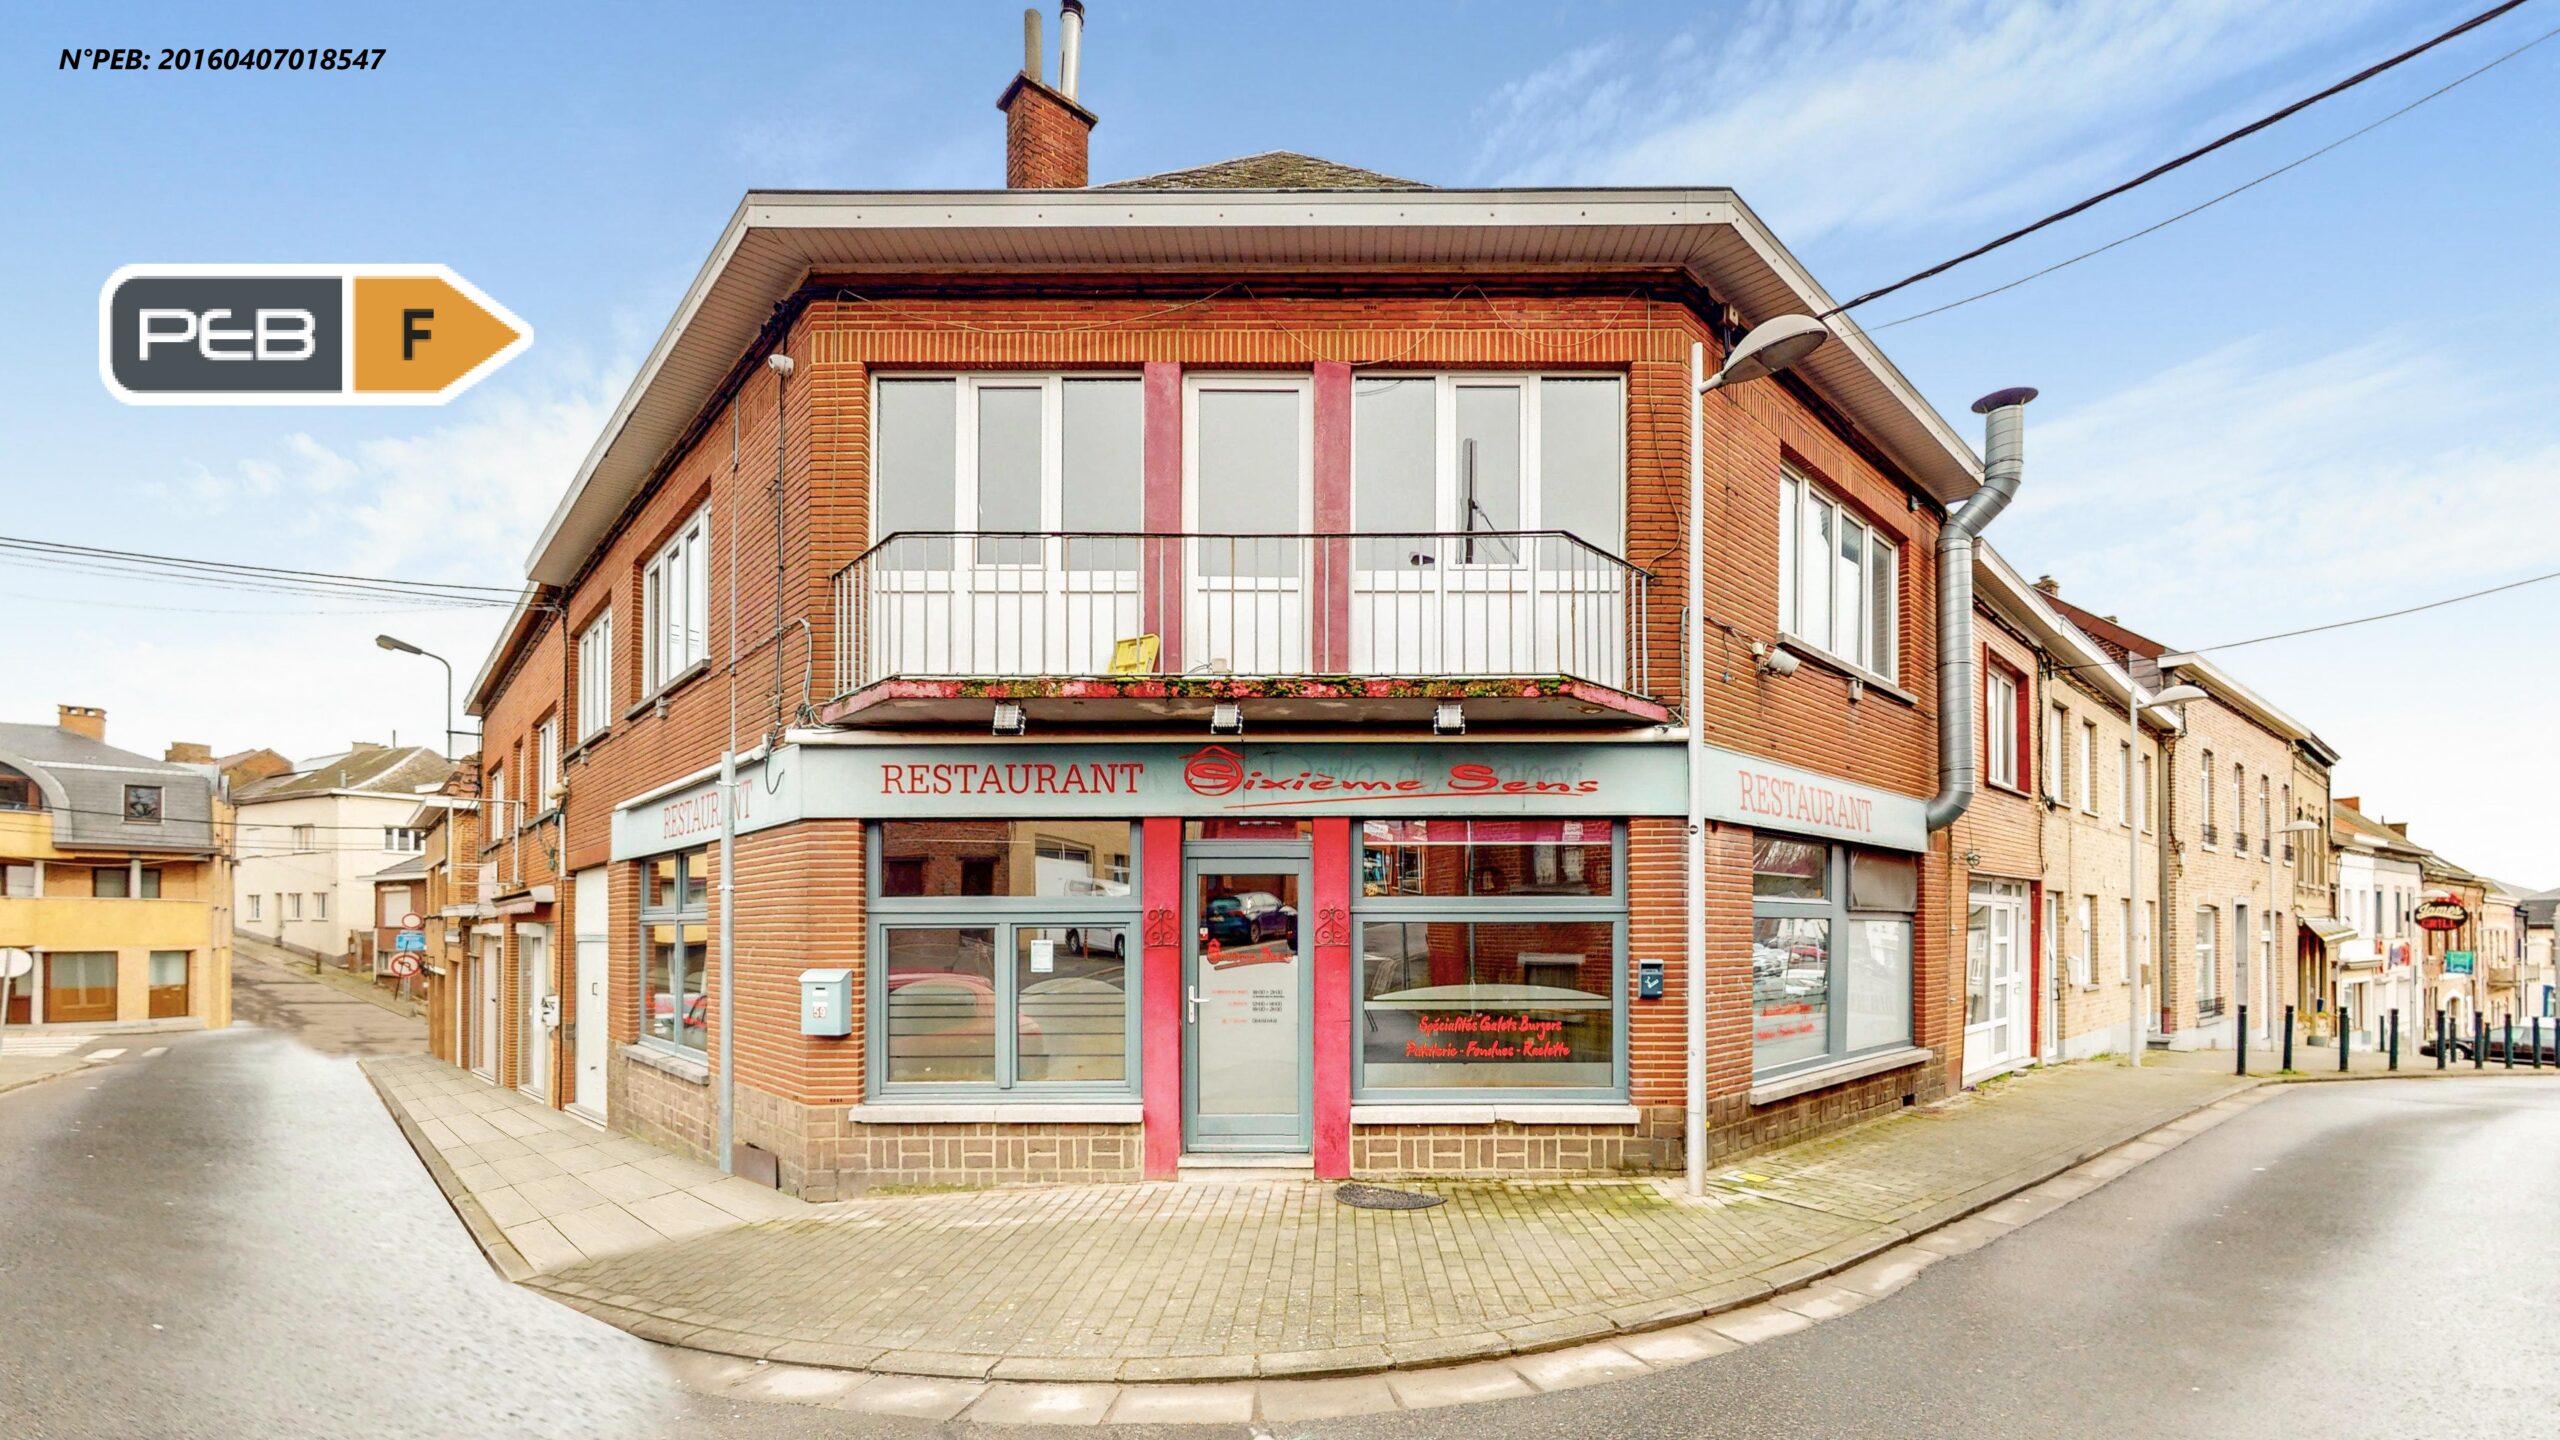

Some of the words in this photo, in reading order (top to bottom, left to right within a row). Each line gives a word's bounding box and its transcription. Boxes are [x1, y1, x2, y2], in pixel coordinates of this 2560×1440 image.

[880, 763, 1144, 794] RESTAURANT
[1180, 746, 1429, 796] Sixième
[1447, 763, 1599, 793] Sens
[663, 779, 753, 839] RESTAURNT
[1738, 770, 1873, 833] RESTAURANT
[1418, 1015, 1478, 1037] Spécialités
[1519, 1015, 1563, 1041] Burgers
[1465, 1040, 1514, 1058] Fondues
